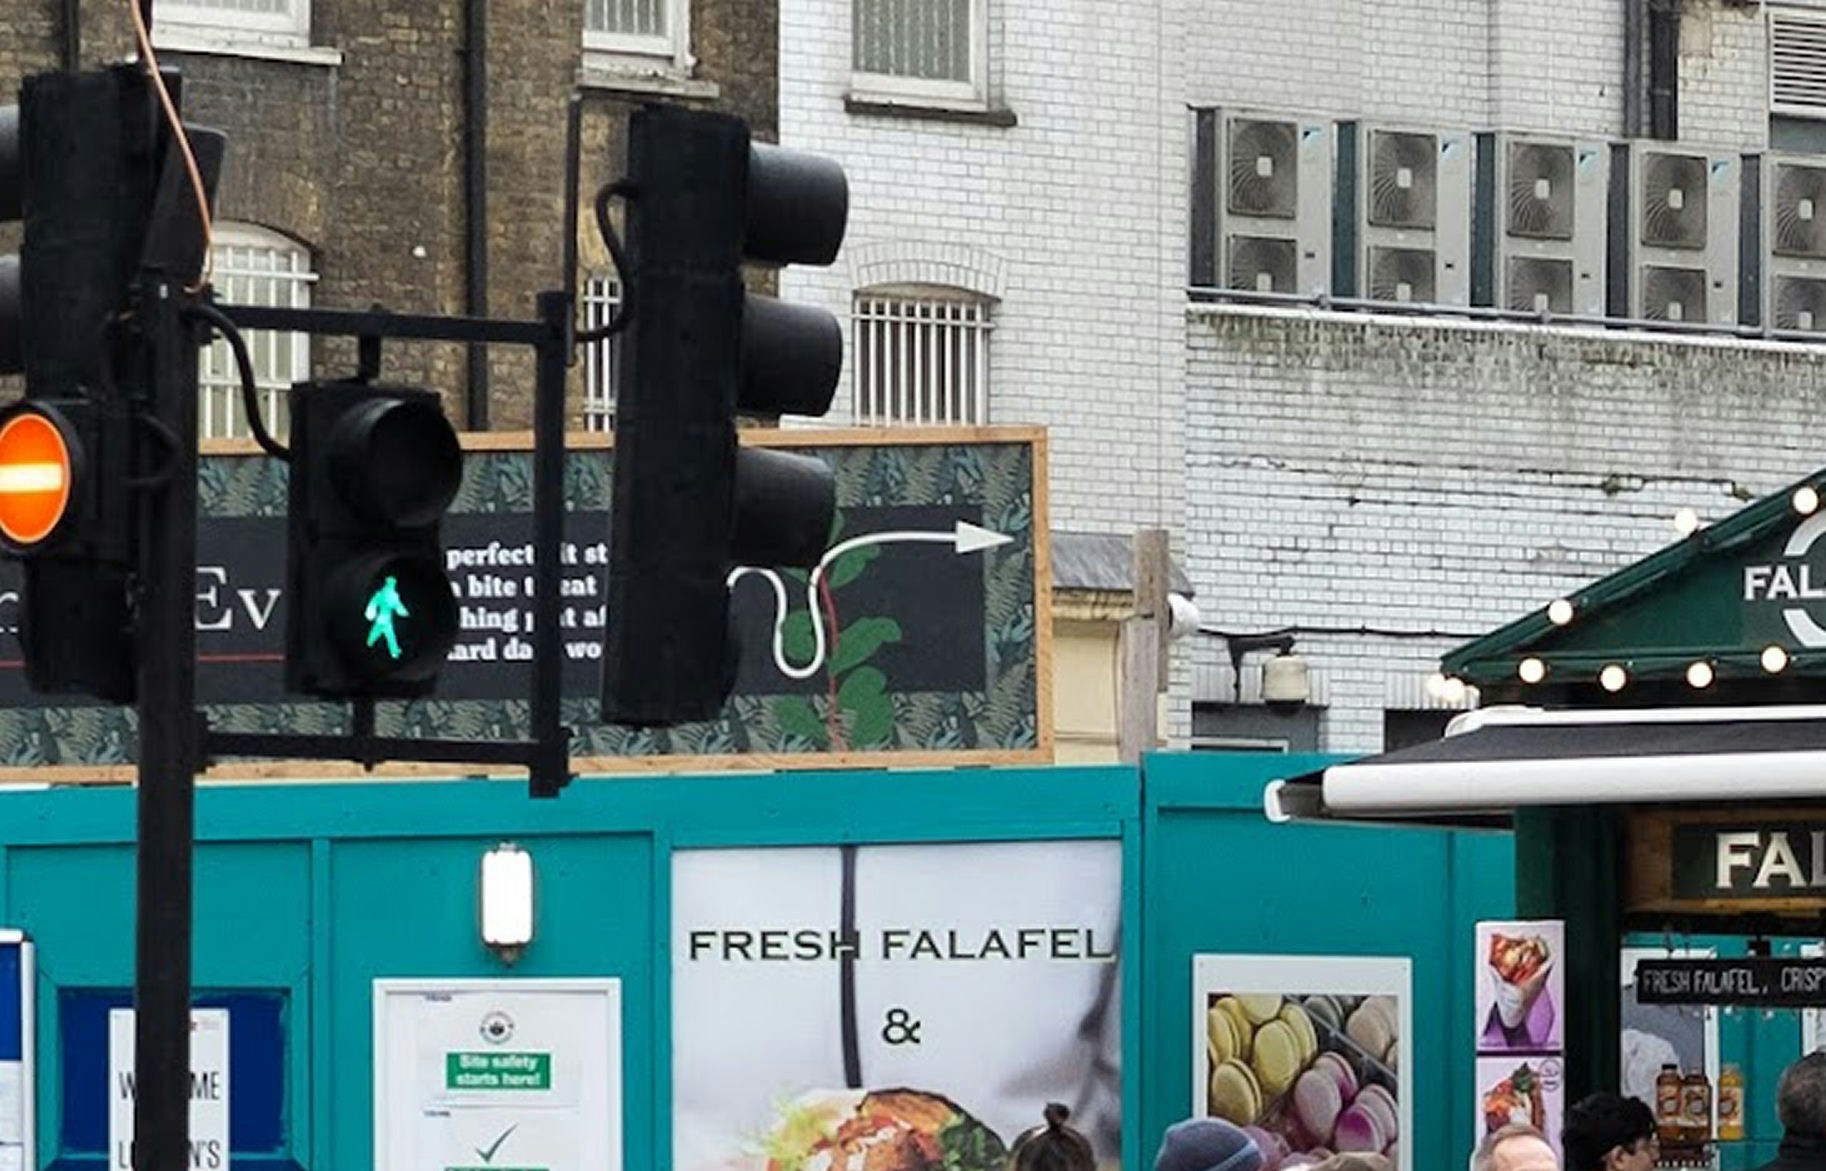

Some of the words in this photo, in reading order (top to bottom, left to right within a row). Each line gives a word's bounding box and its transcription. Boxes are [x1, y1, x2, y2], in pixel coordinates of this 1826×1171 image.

[446, 541, 534, 571] perfect
[584, 542, 608, 564] st
[467, 574, 517, 598] bite
[459, 605, 519, 633] hing
[503, 637, 534, 660] da
[565, 642, 602, 659] wo
[689, 930, 861, 961] FRESH
[882, 929, 1117, 960] FALAFEL
[1643, 969, 1690, 993] FRESH
[881, 1008, 921, 1045] &
